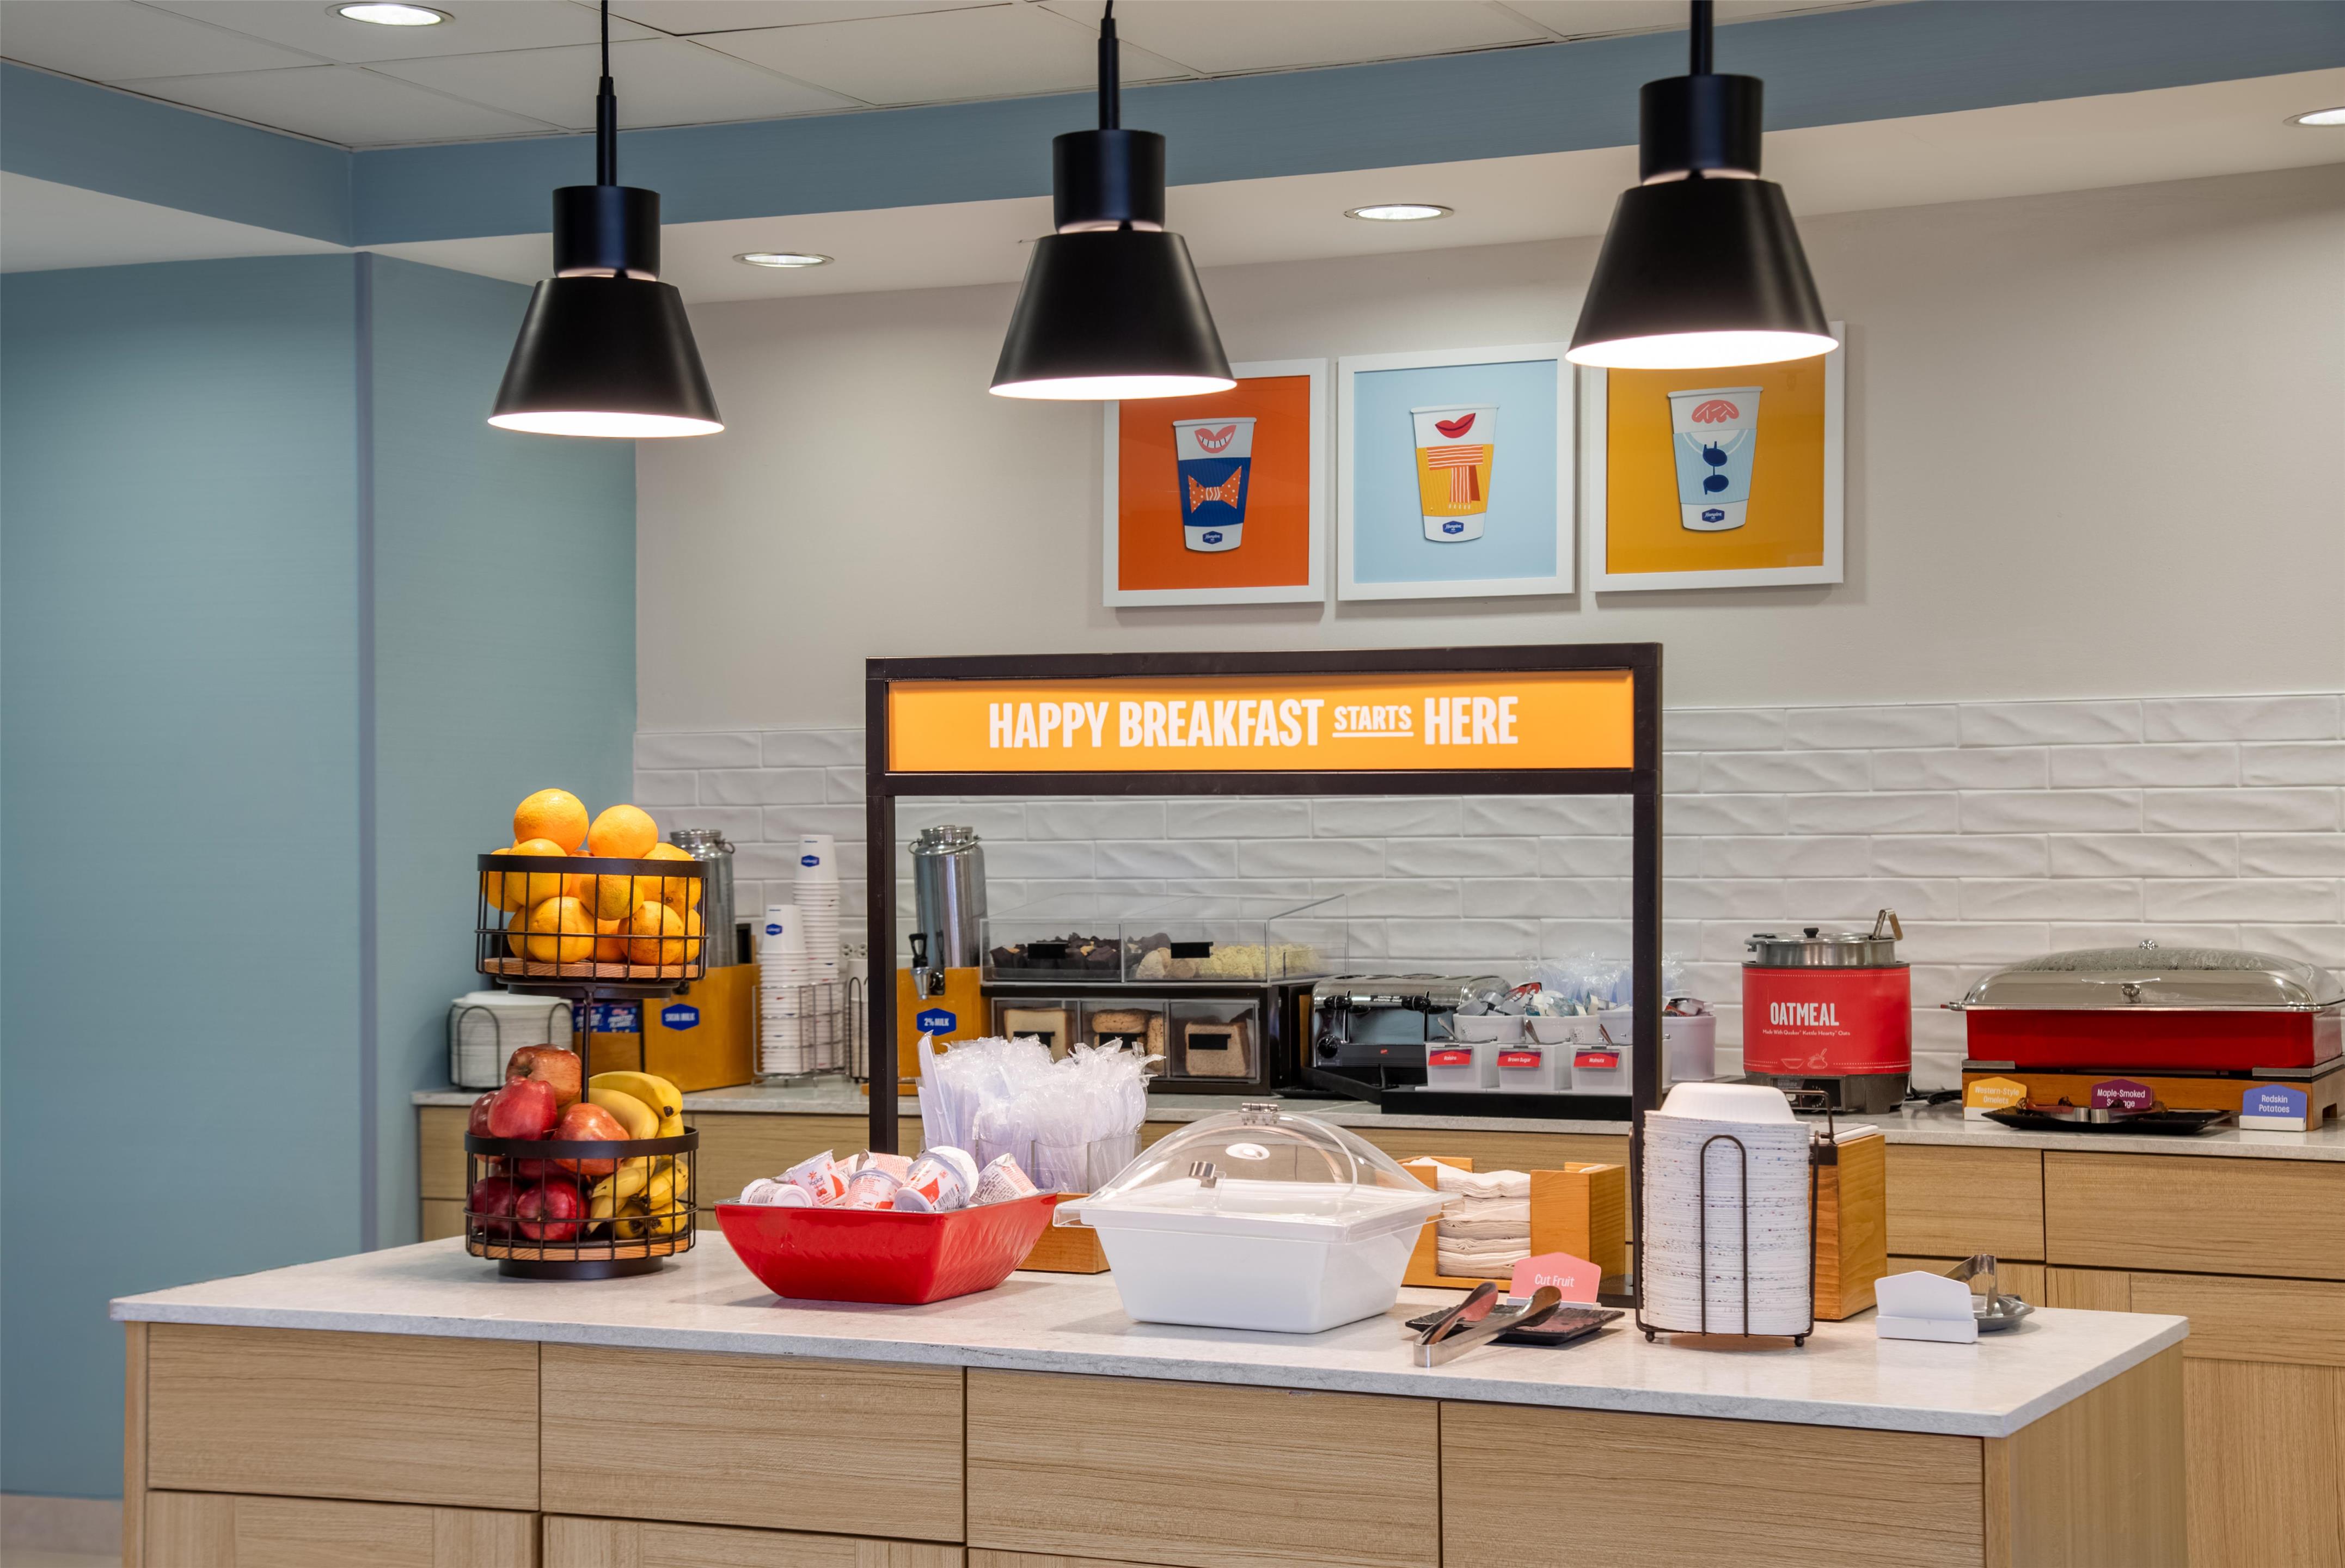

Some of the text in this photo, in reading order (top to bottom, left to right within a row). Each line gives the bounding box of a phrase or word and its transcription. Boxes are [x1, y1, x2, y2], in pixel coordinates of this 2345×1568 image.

[989, 696, 1519, 748] HAPPY BREAKFAST STARTS HERE
[681, 1012, 696, 1021] MILK
[1770, 1002, 1840, 1026] OATMEAL
[924, 1018, 949, 1026] 2% MILK
[1975, 1086, 2019, 1097] Western-Style
[2097, 1088, 2145, 1098] Maple-Smoked
[1983, 1095, 2009, 1105] Omelets
[2261, 1094, 2288, 1104] Redskin
[2258, 1104, 2290, 1113] Potatoes
[1534, 1273, 1575, 1288] Cut Fruit
